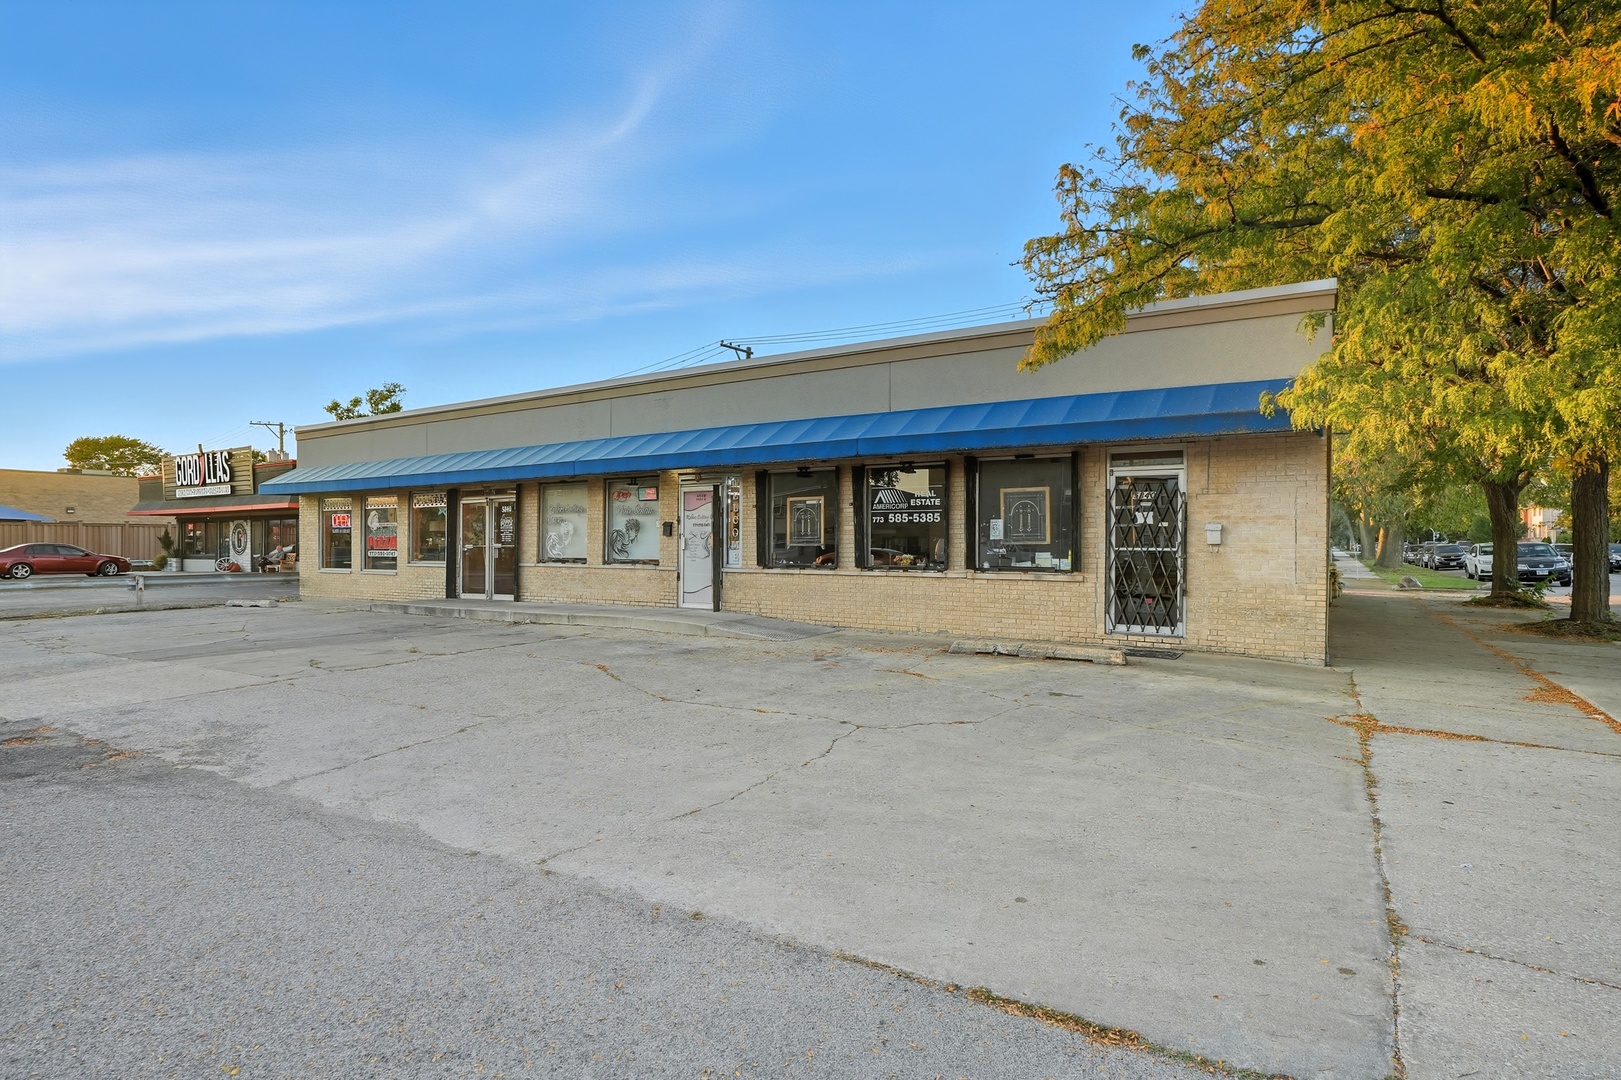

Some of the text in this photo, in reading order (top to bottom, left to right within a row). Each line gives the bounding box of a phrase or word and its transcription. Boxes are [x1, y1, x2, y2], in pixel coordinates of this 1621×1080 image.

[914, 490, 937, 498] REAL
[910, 498, 941, 506] ESTATE
[888, 513, 941, 523] 585-5385
